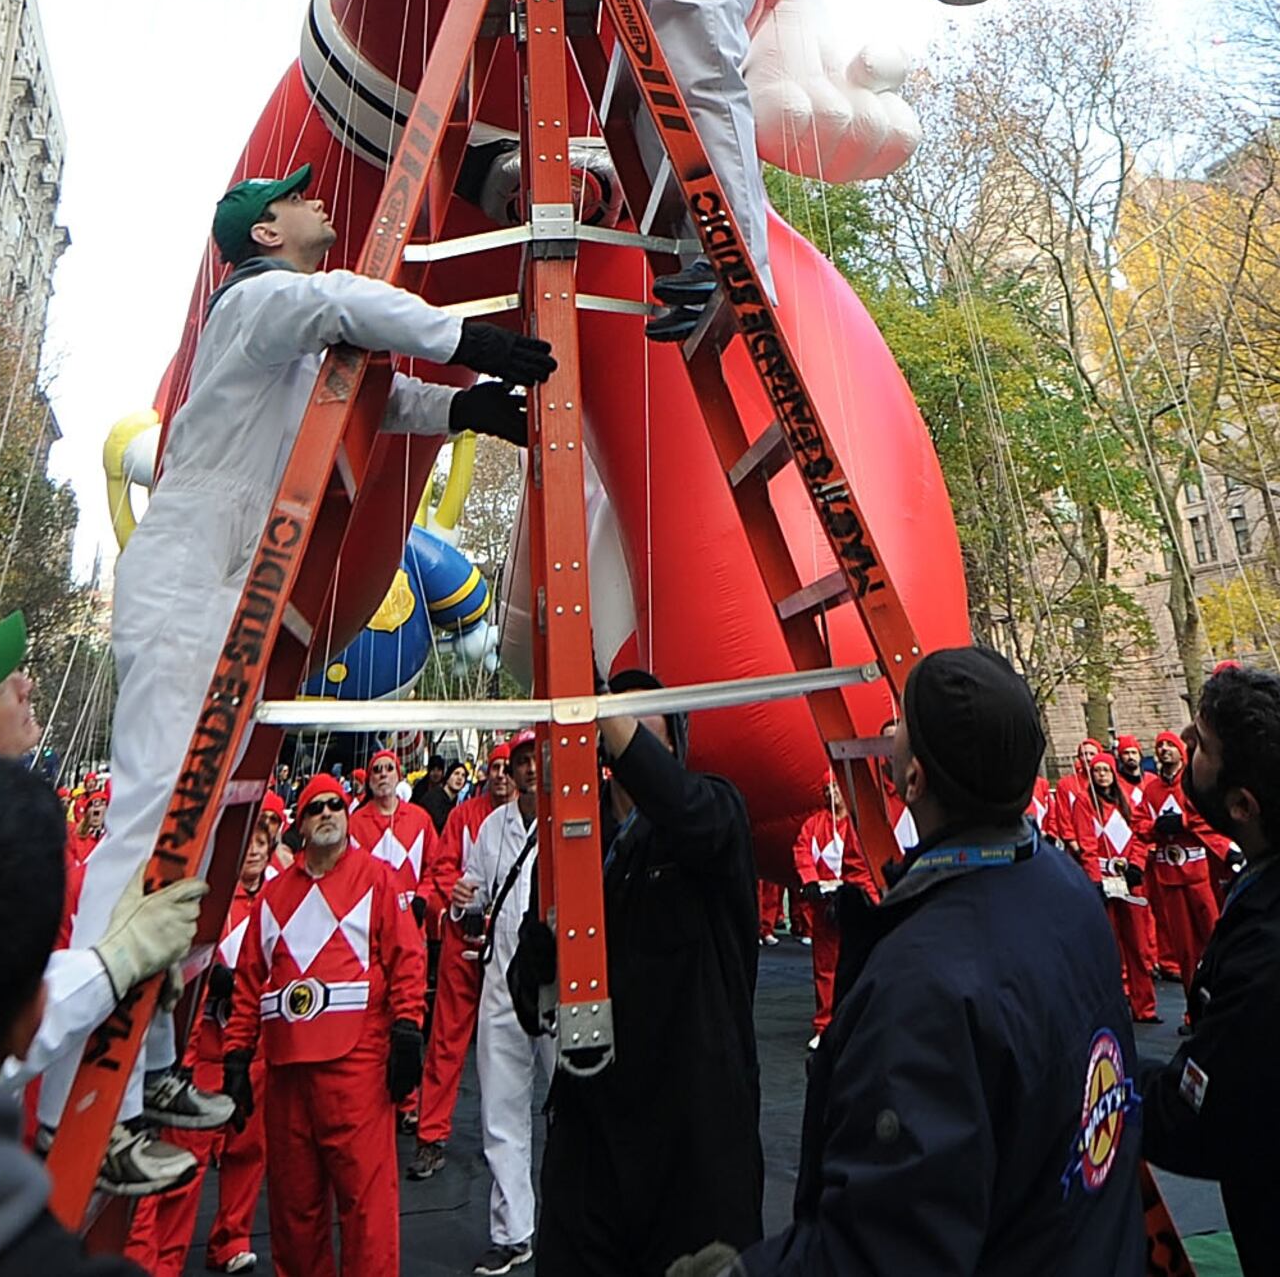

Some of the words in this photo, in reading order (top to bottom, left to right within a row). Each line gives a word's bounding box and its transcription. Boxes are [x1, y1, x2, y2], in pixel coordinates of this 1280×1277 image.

[690, 190, 764, 306] STUDIO
[152, 676, 251, 866] PARADE
[223, 515, 302, 667] STUDIO
